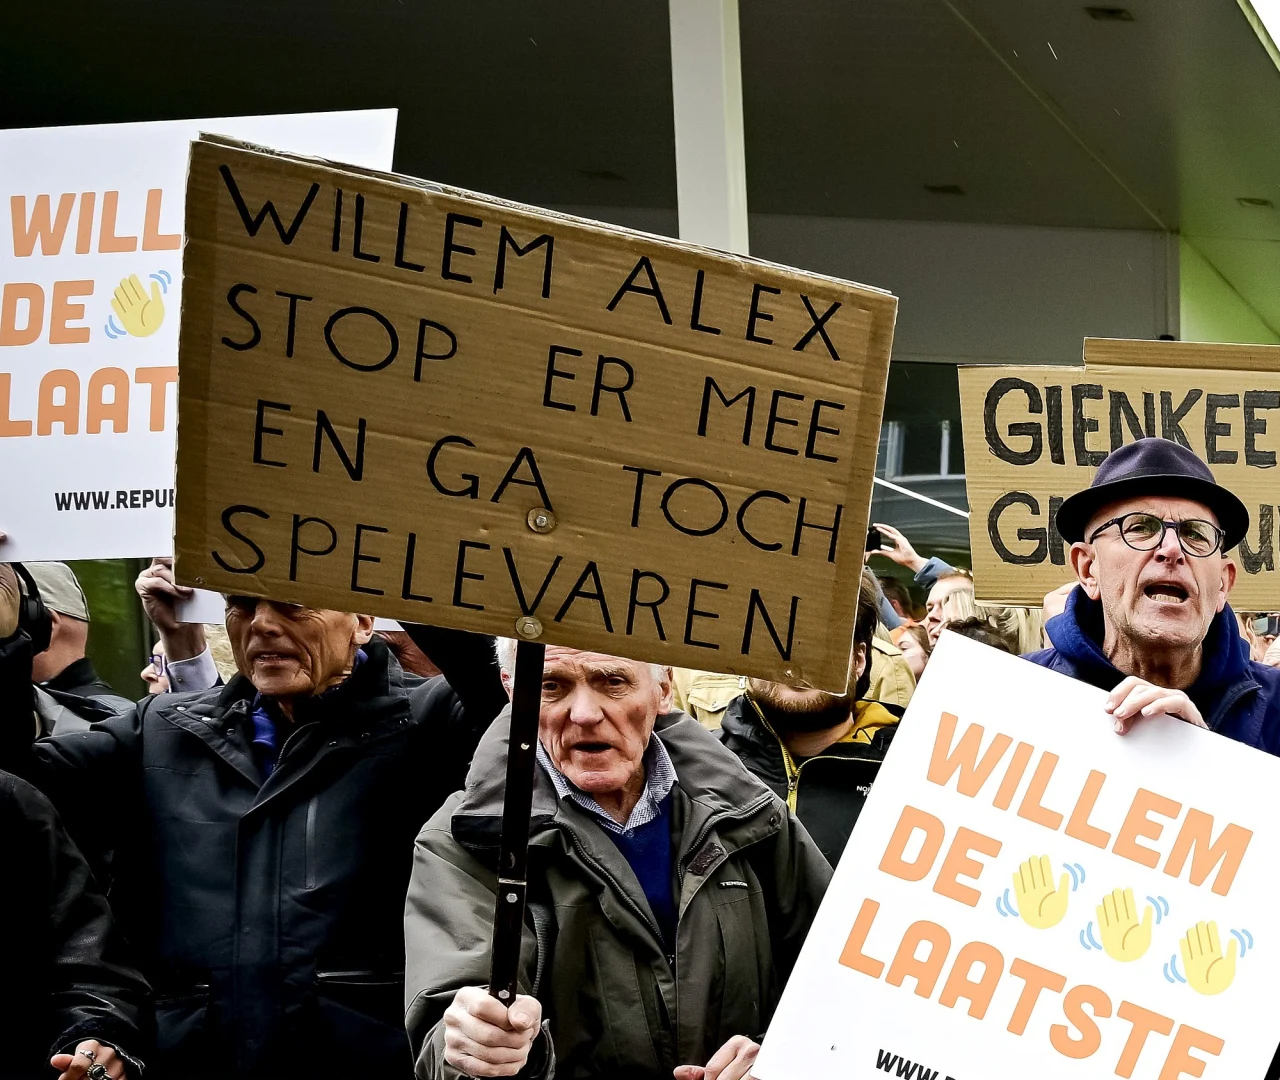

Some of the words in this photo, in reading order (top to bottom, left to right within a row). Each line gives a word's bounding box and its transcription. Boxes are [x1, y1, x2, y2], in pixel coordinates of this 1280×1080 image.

[10, 188, 182, 257] WILL
[218, 164, 556, 298] WILLEM
[606, 256, 842, 362] ALEX
[0, 280, 94, 346] DE
[221, 283, 459, 381] STOP
[543, 344, 636, 422] ER
[698, 375, 846, 462] MEE
[0, 366, 178, 437] LAAT
[253, 400, 368, 482] EN
[425, 435, 554, 512] GA
[622, 465, 844, 563] TOCH
[211, 504, 801, 662] SPELEVAREN
[878, 804, 1003, 908] DE
[927, 711, 1254, 897] WILLEM
